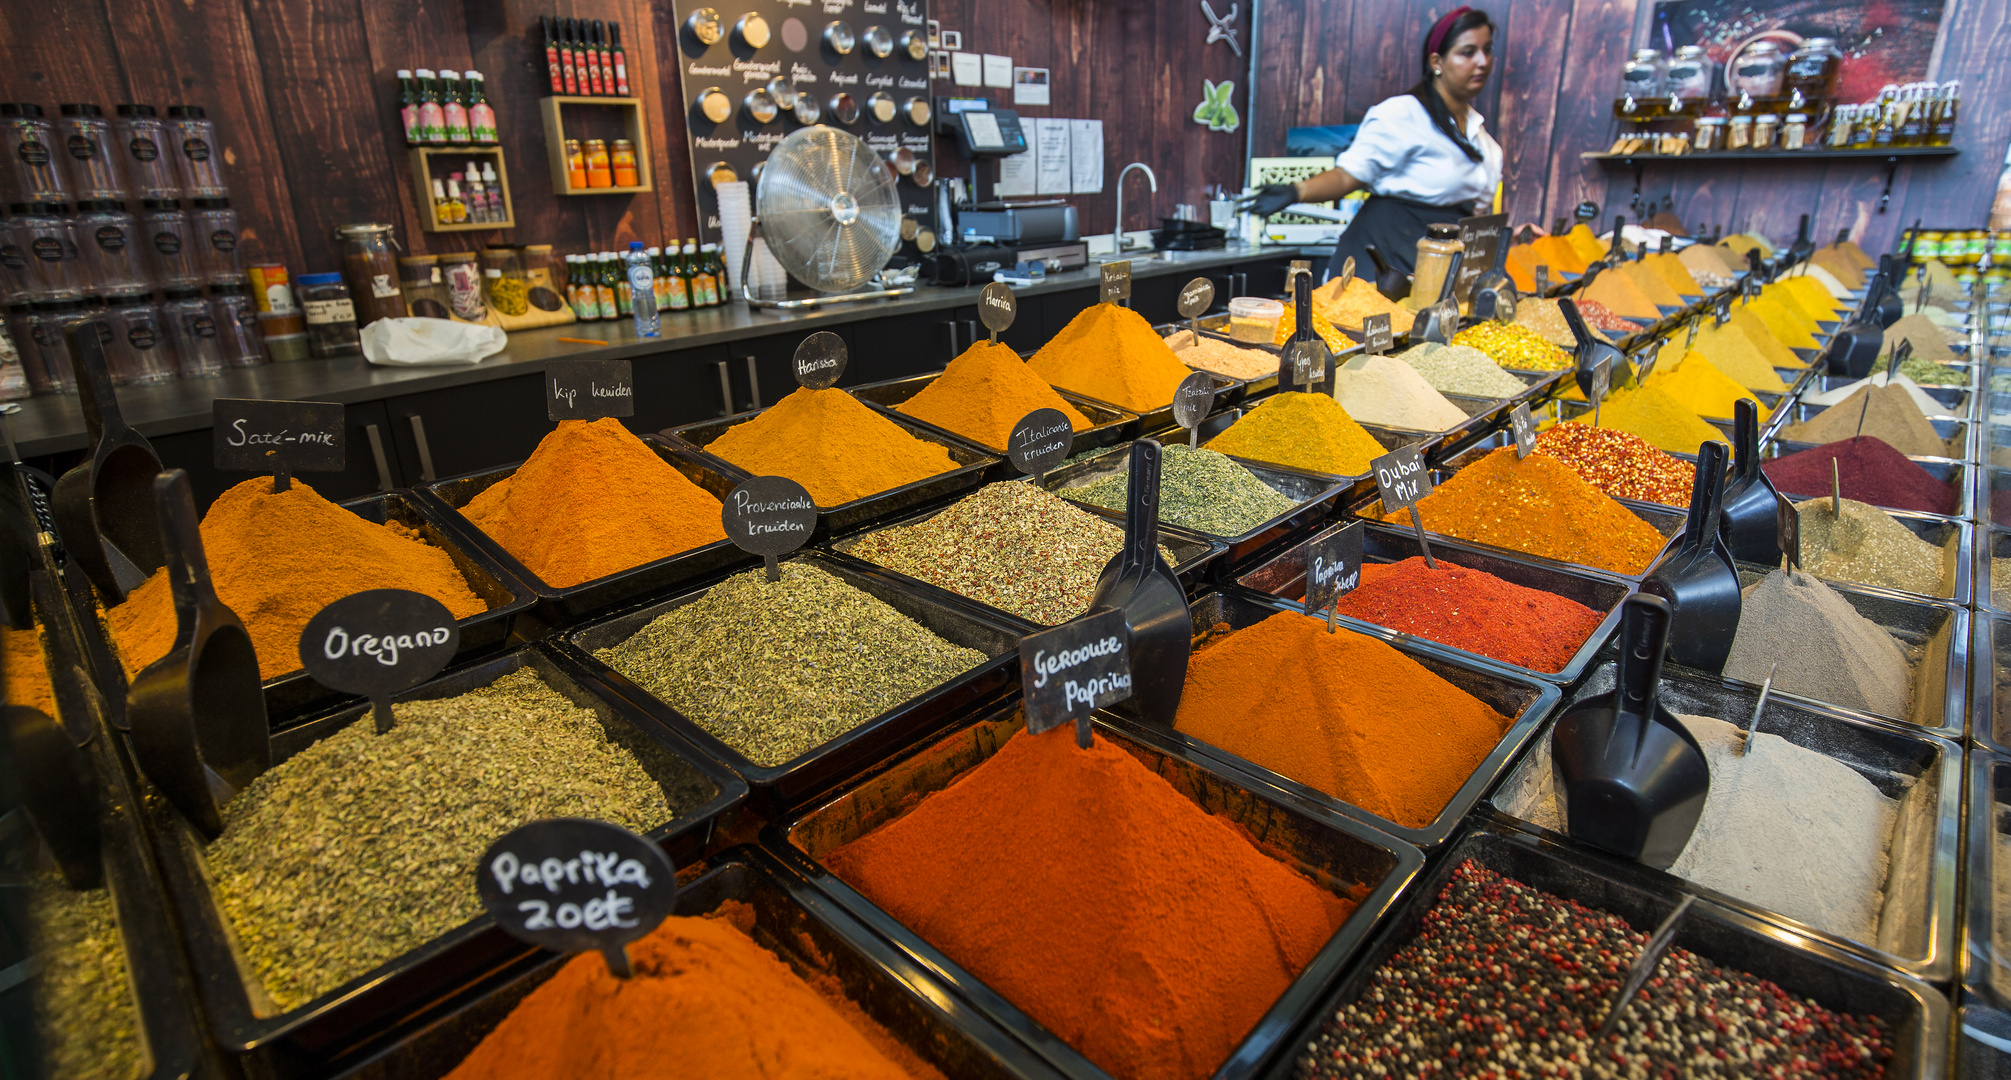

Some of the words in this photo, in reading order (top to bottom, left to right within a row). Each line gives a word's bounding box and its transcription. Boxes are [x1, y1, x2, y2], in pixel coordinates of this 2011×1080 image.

[226, 418, 335, 447] Saté-mix
[1380, 454, 1421, 489] Dubai
[1394, 479, 1419, 501] Mix
[748, 519, 805, 536] kruiden
[324, 626, 450, 666] Oregano
[490, 850, 652, 894] Paprika
